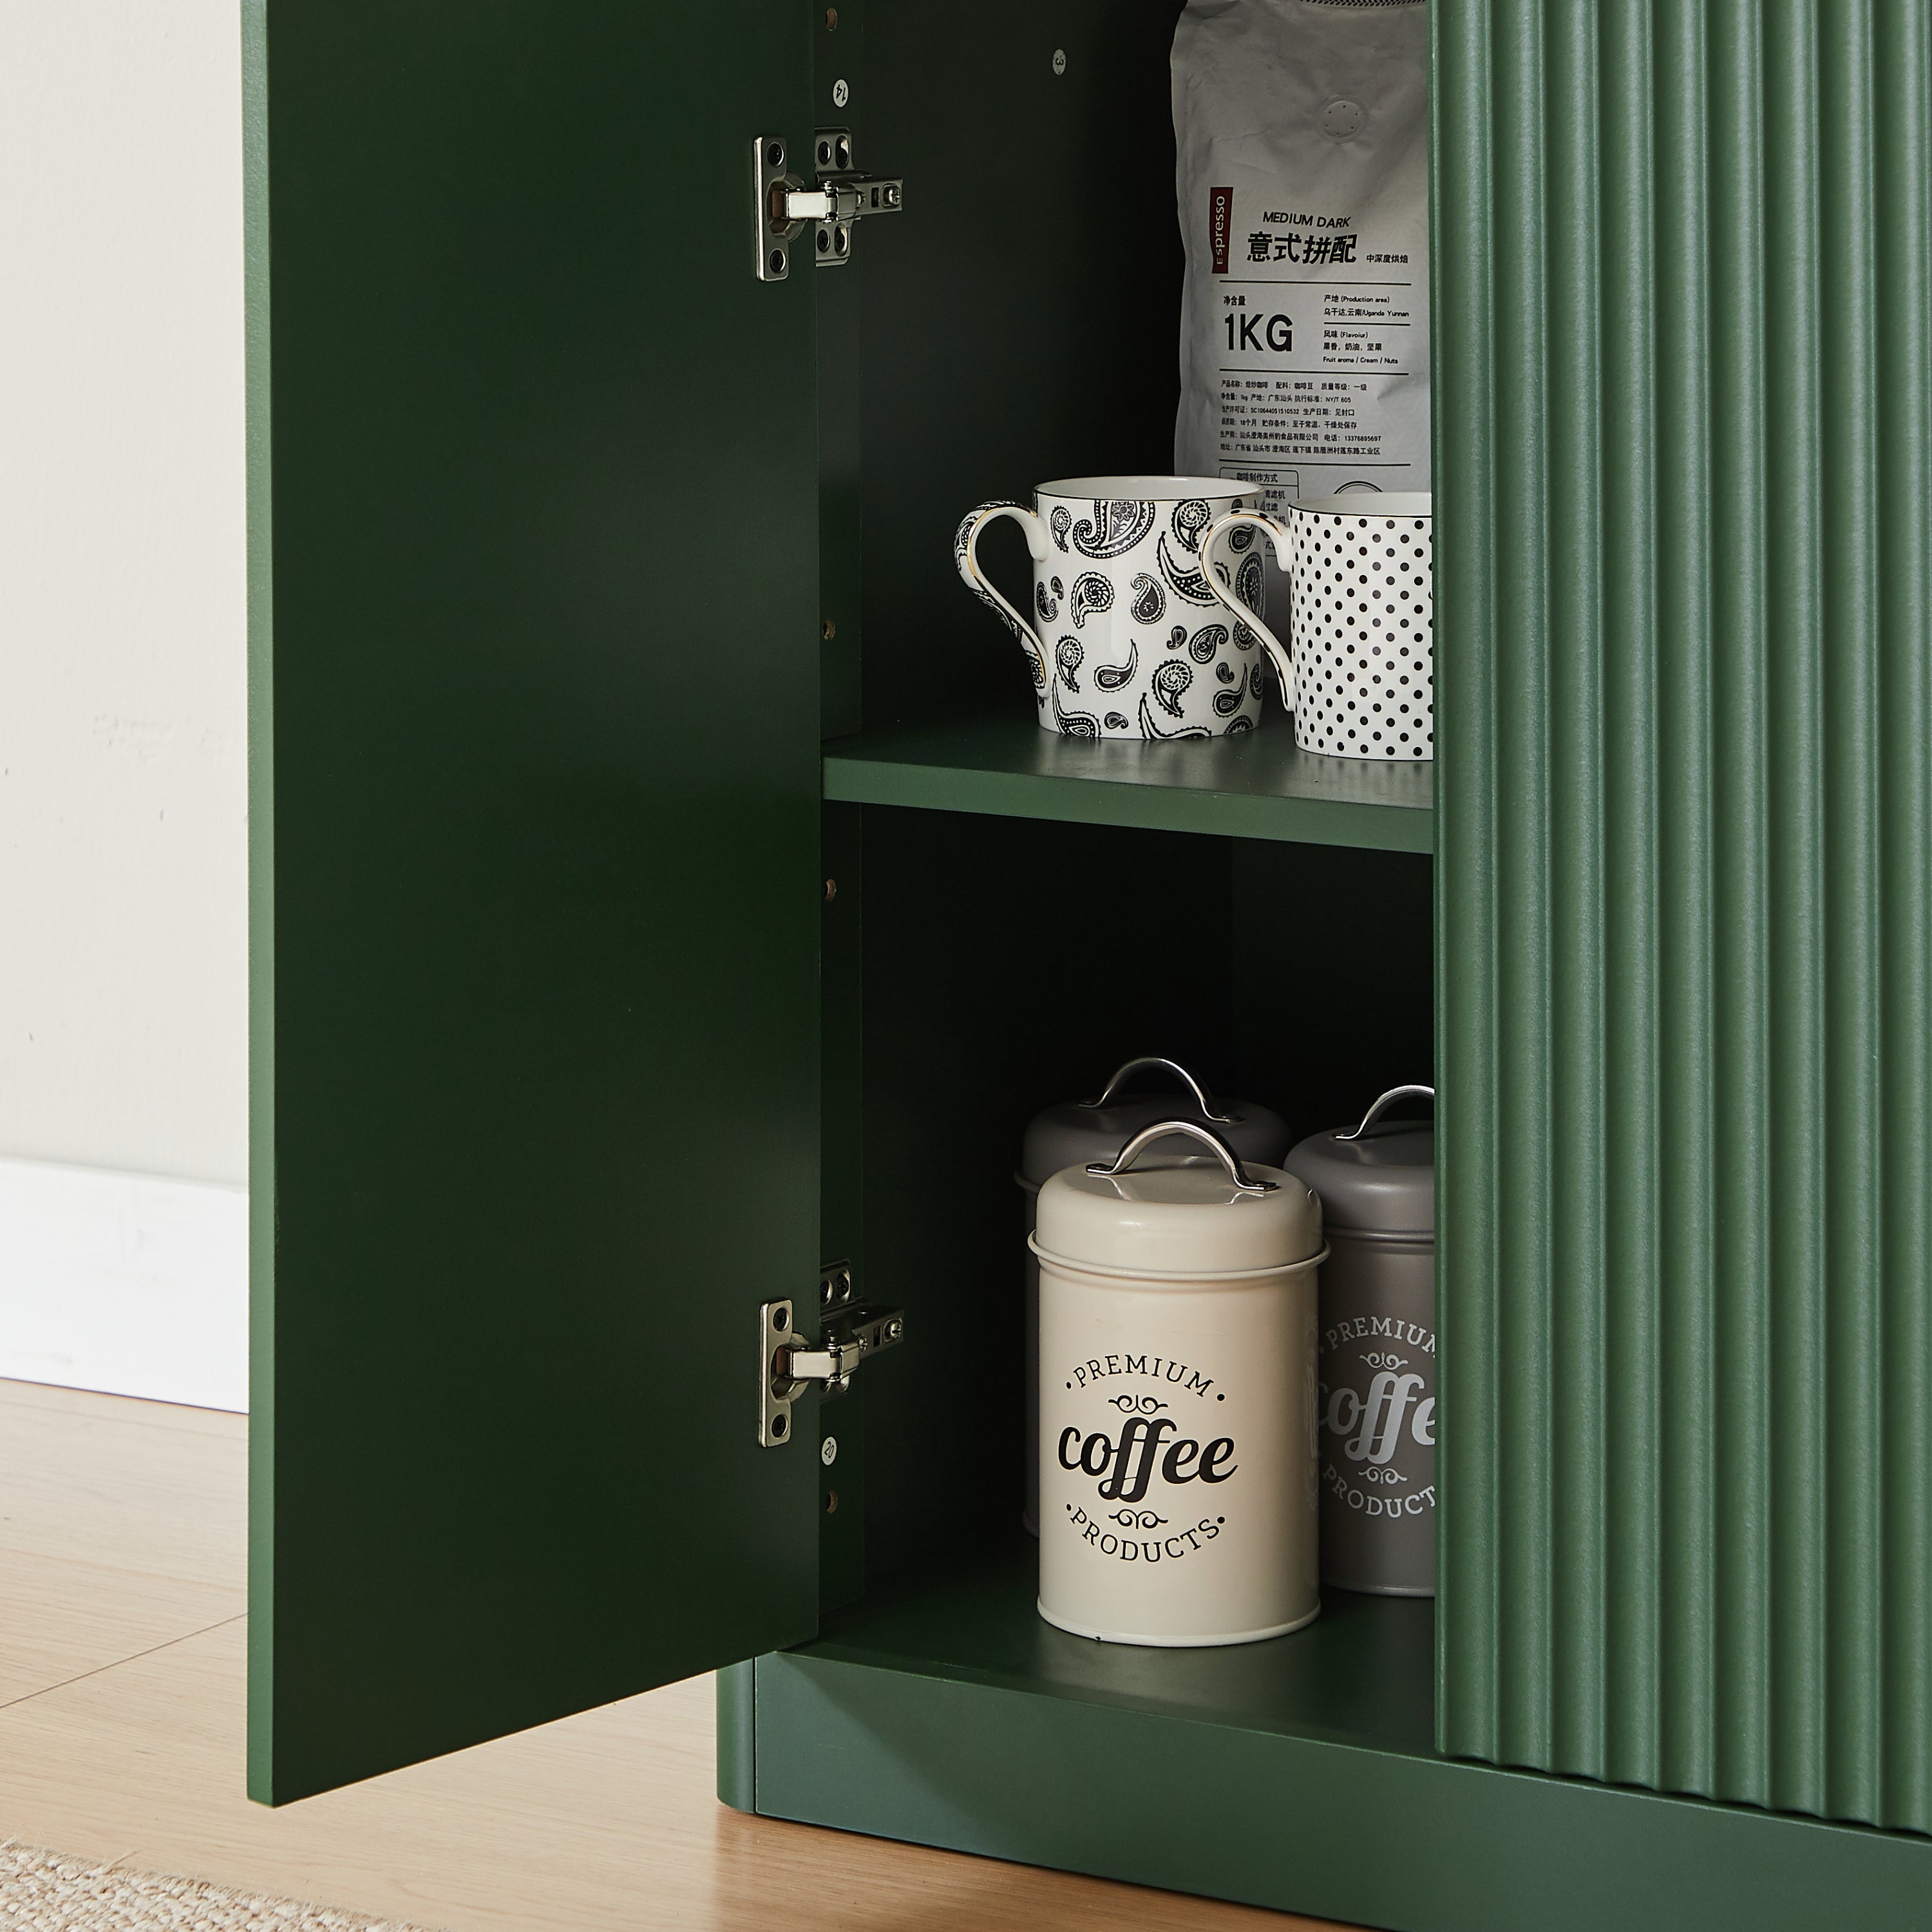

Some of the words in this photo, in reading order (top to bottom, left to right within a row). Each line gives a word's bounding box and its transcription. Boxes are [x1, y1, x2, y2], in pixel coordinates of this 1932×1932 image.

[1216, 196, 1225, 264] Espresso
[1263, 211, 1313, 226] MEDIUM
[1317, 216, 1351, 228] DARK
[1247, 231, 1357, 264] 意式拼配
[1367, 254, 1408, 263] 中深度烘焙
[1224, 296, 1245, 306] 净含量
[1324, 294, 1339, 303] 产地
[1225, 314, 1293, 352] 1KG
[1236, 471, 1278, 483] 咖啡制作方式
[1074, 1355, 1214, 1397] PREMIUM
[824, 1441, 835, 1459] 20
[1058, 1417, 1238, 1503] coffee
[1069, 1507, 1220, 1562] PRODUCTS
